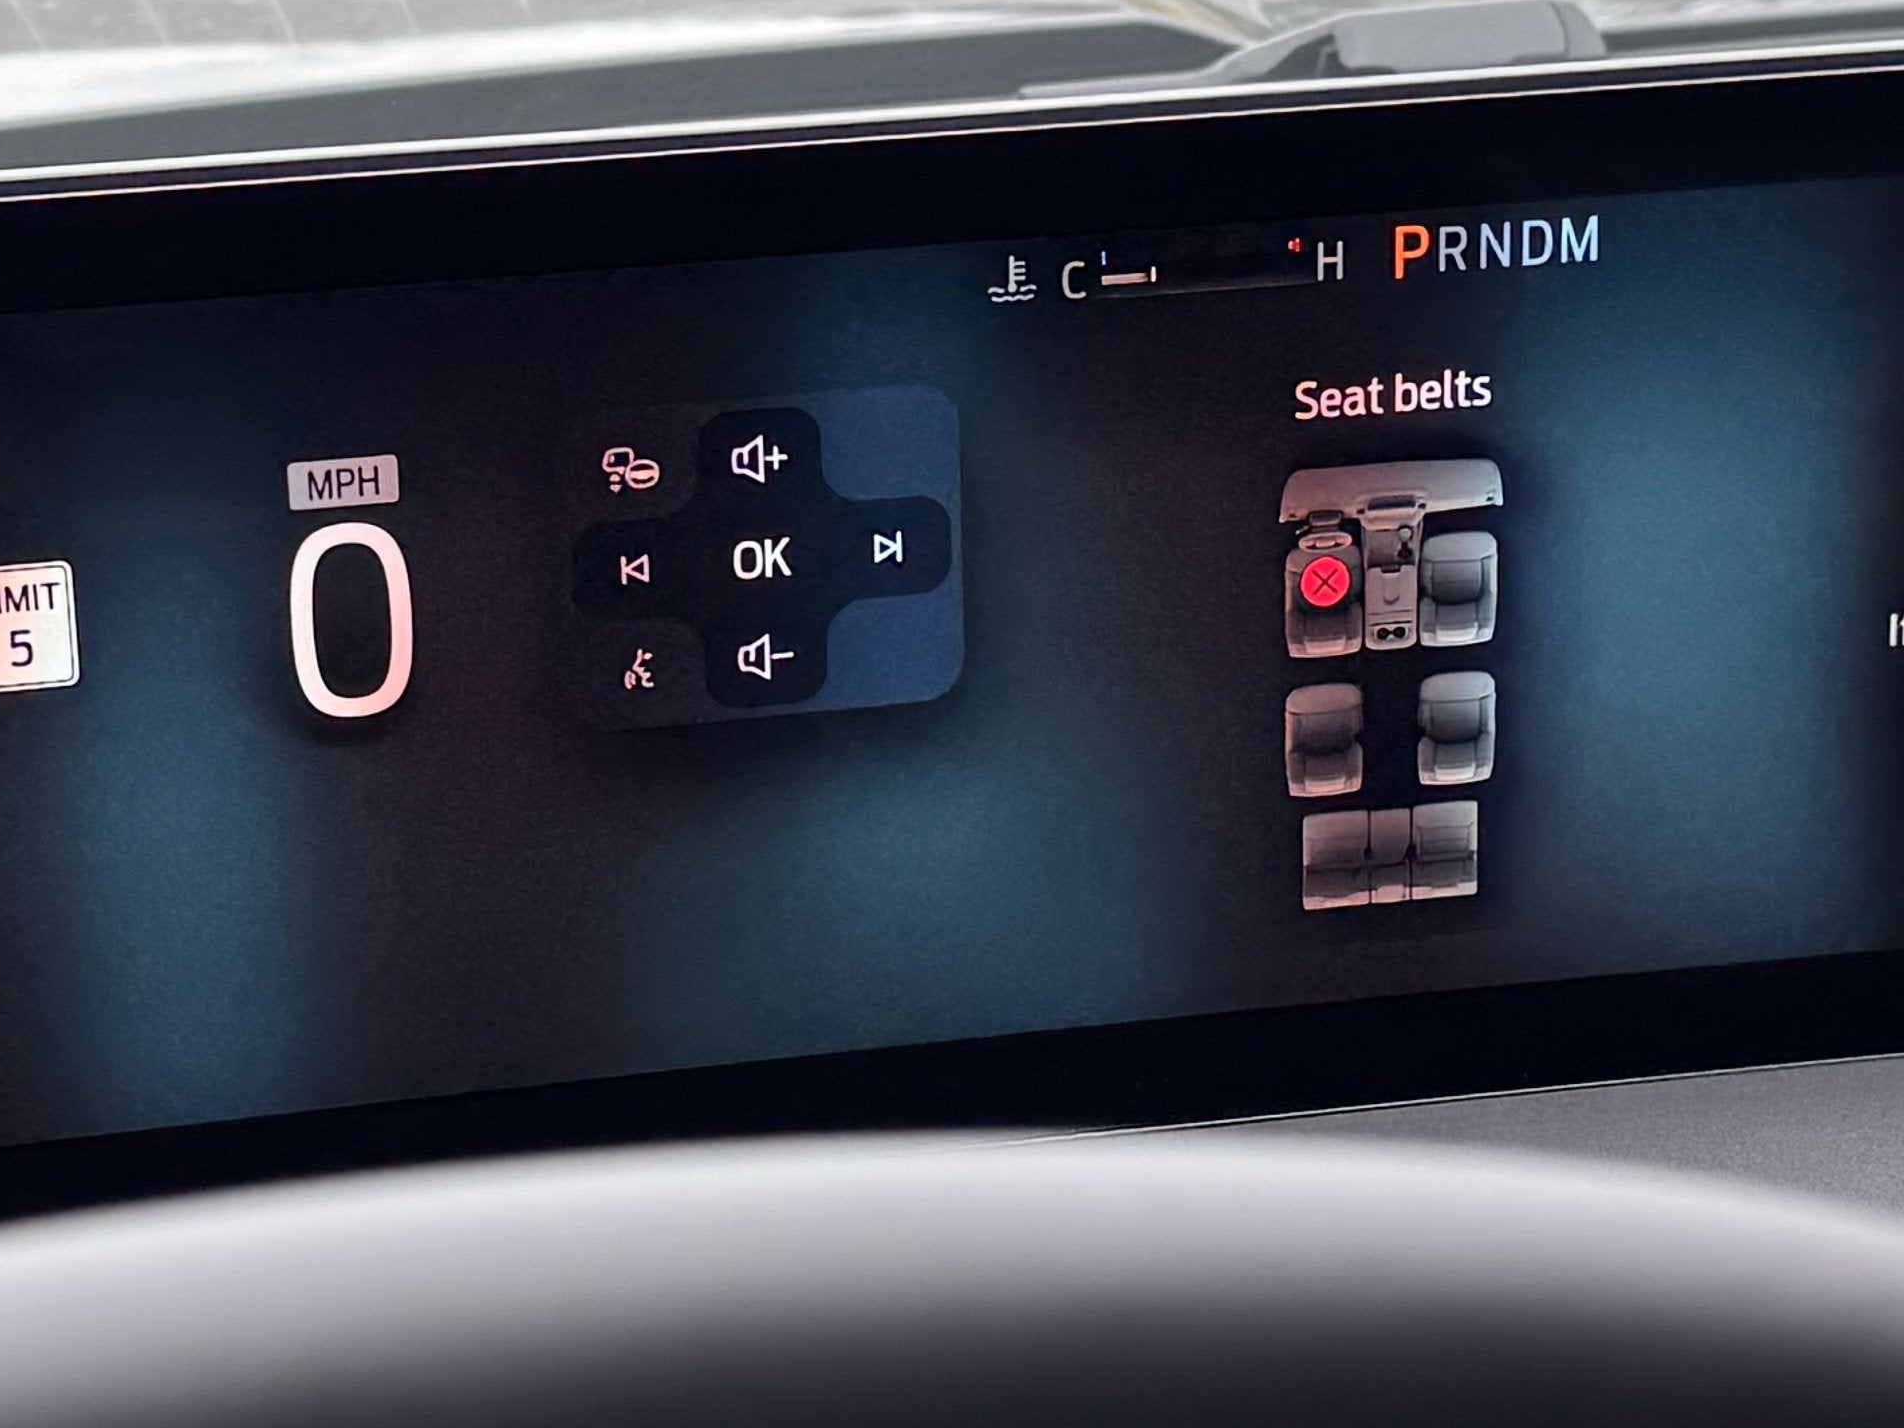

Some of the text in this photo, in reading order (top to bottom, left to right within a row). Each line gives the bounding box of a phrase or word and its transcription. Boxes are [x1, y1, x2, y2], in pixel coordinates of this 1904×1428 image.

[1061, 240, 1345, 300] C H
[1294, 369, 1493, 421] Seat belts
[307, 467, 382, 501] MPH
[732, 537, 793, 581] OK
[290, 521, 414, 719] 0
[10, 629, 35, 669] 5
